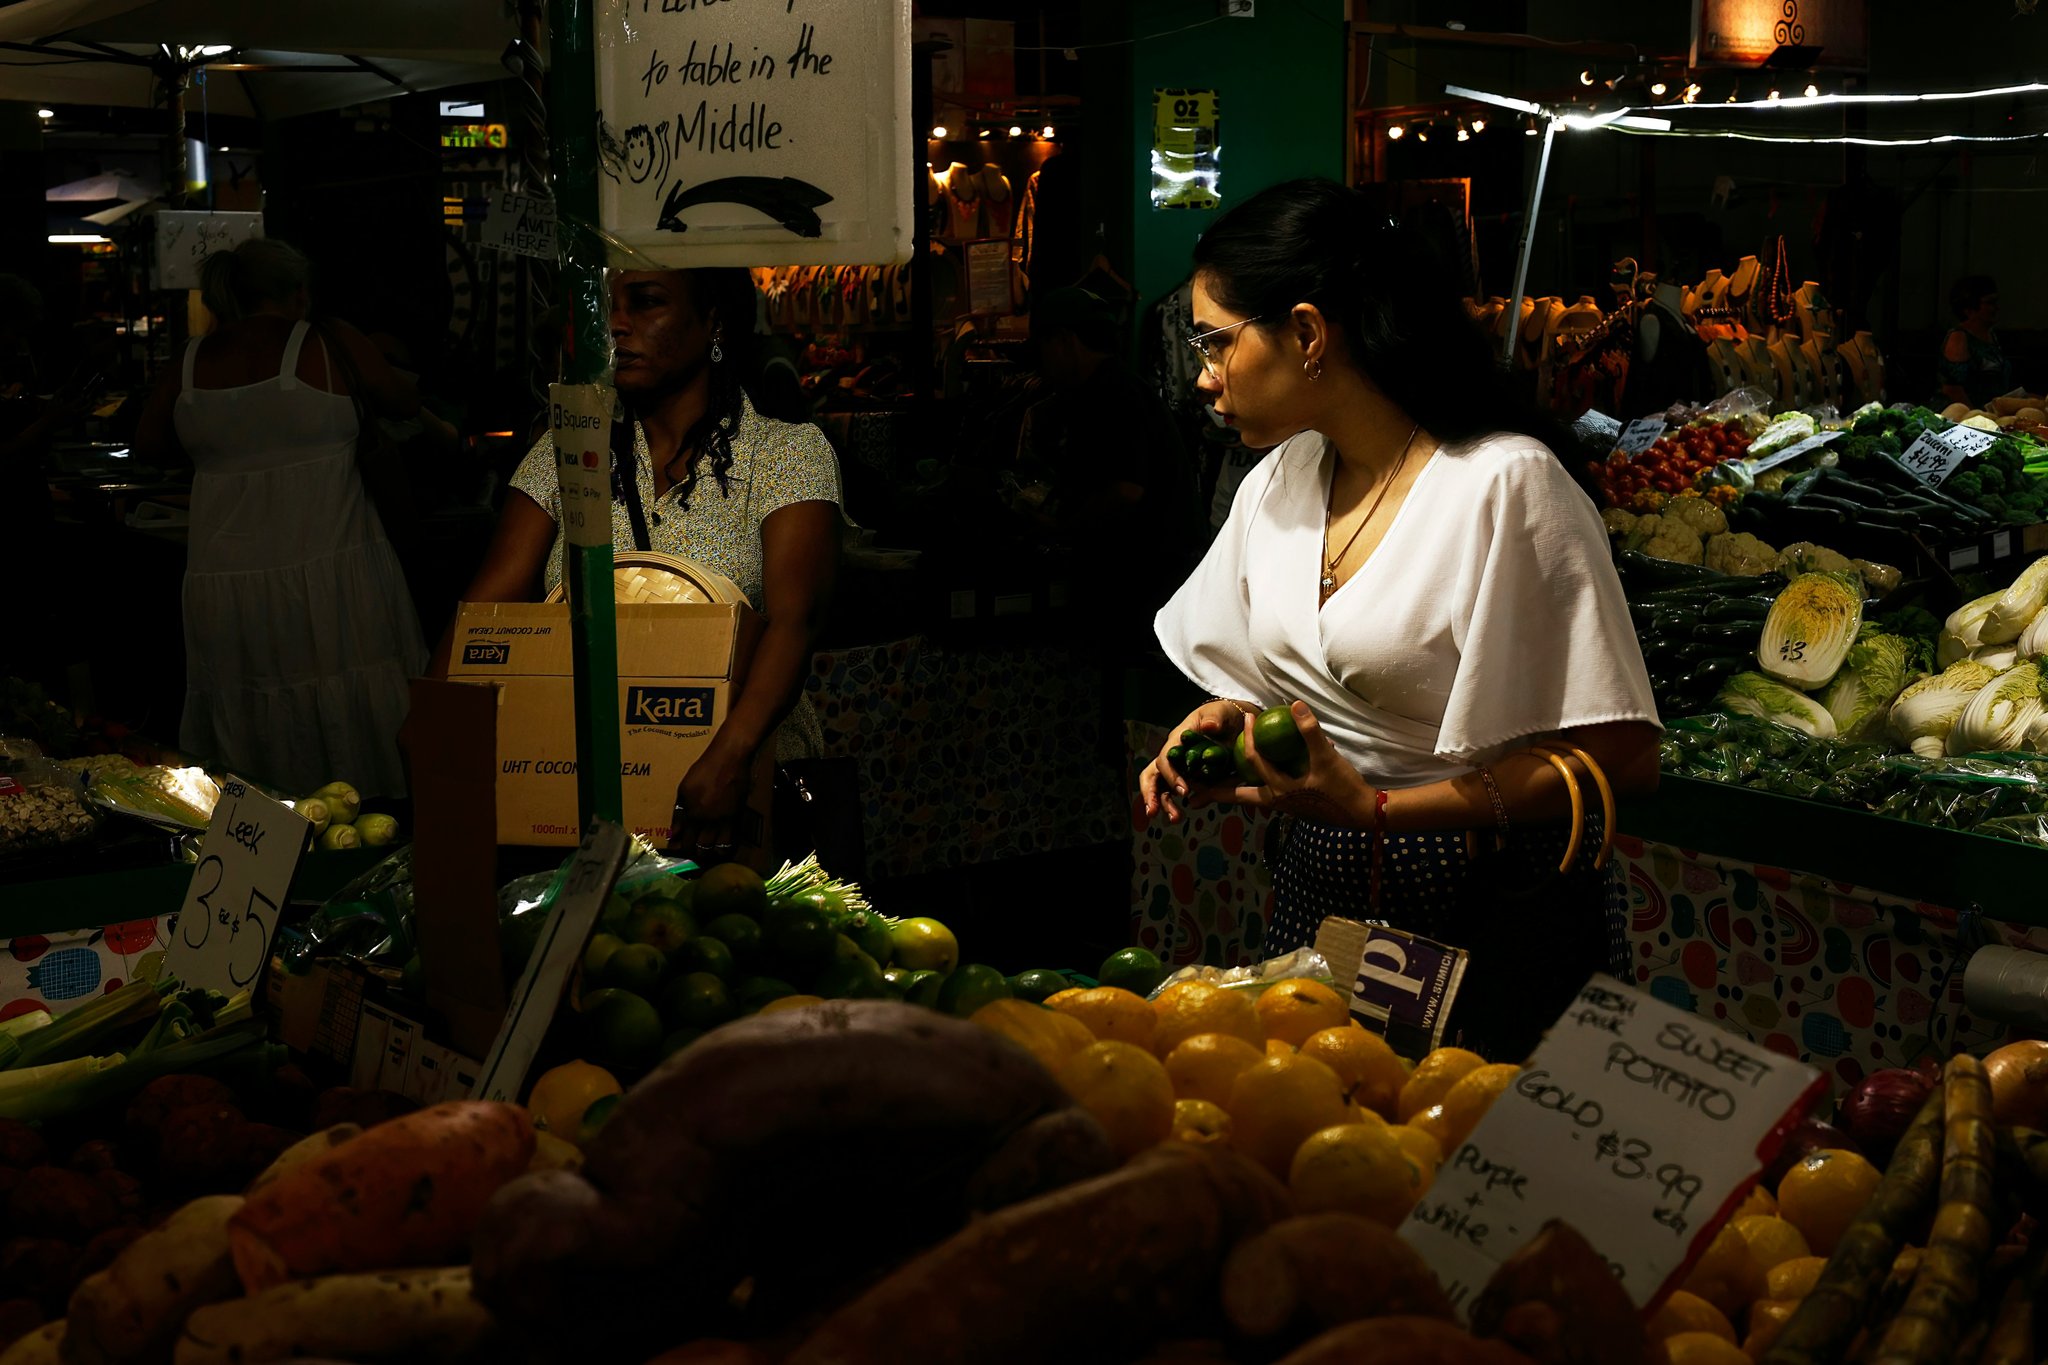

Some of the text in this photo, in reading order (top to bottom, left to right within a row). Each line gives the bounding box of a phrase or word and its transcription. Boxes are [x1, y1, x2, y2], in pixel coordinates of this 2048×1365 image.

[642, 23, 832, 97] to table in the
[1174, 100, 1199, 117] OZ
[503, 232, 550, 250] HERE
[563, 410, 600, 431] Square
[564, 453, 579, 466] VISA
[584, 487, 589, 497] G
[468, 627, 552, 635] UHT COCONUT CREAM
[635, 689, 705, 723] kara
[628, 727, 642, 736] The
[643, 725, 672, 737] Coconut
[502, 760, 531, 774] UHT
[226, 803, 266, 855] Leek
[531, 824, 568, 835] 1000ml
[635, 827, 652, 837] Net
[184, 855, 223, 949] 3
[1656, 1022, 1772, 1086] SWEET
[1604, 1042, 1736, 1120] POTATO
[1516, 1070, 1603, 1128] GOLD
[1596, 1130, 1702, 1211] $3.99
